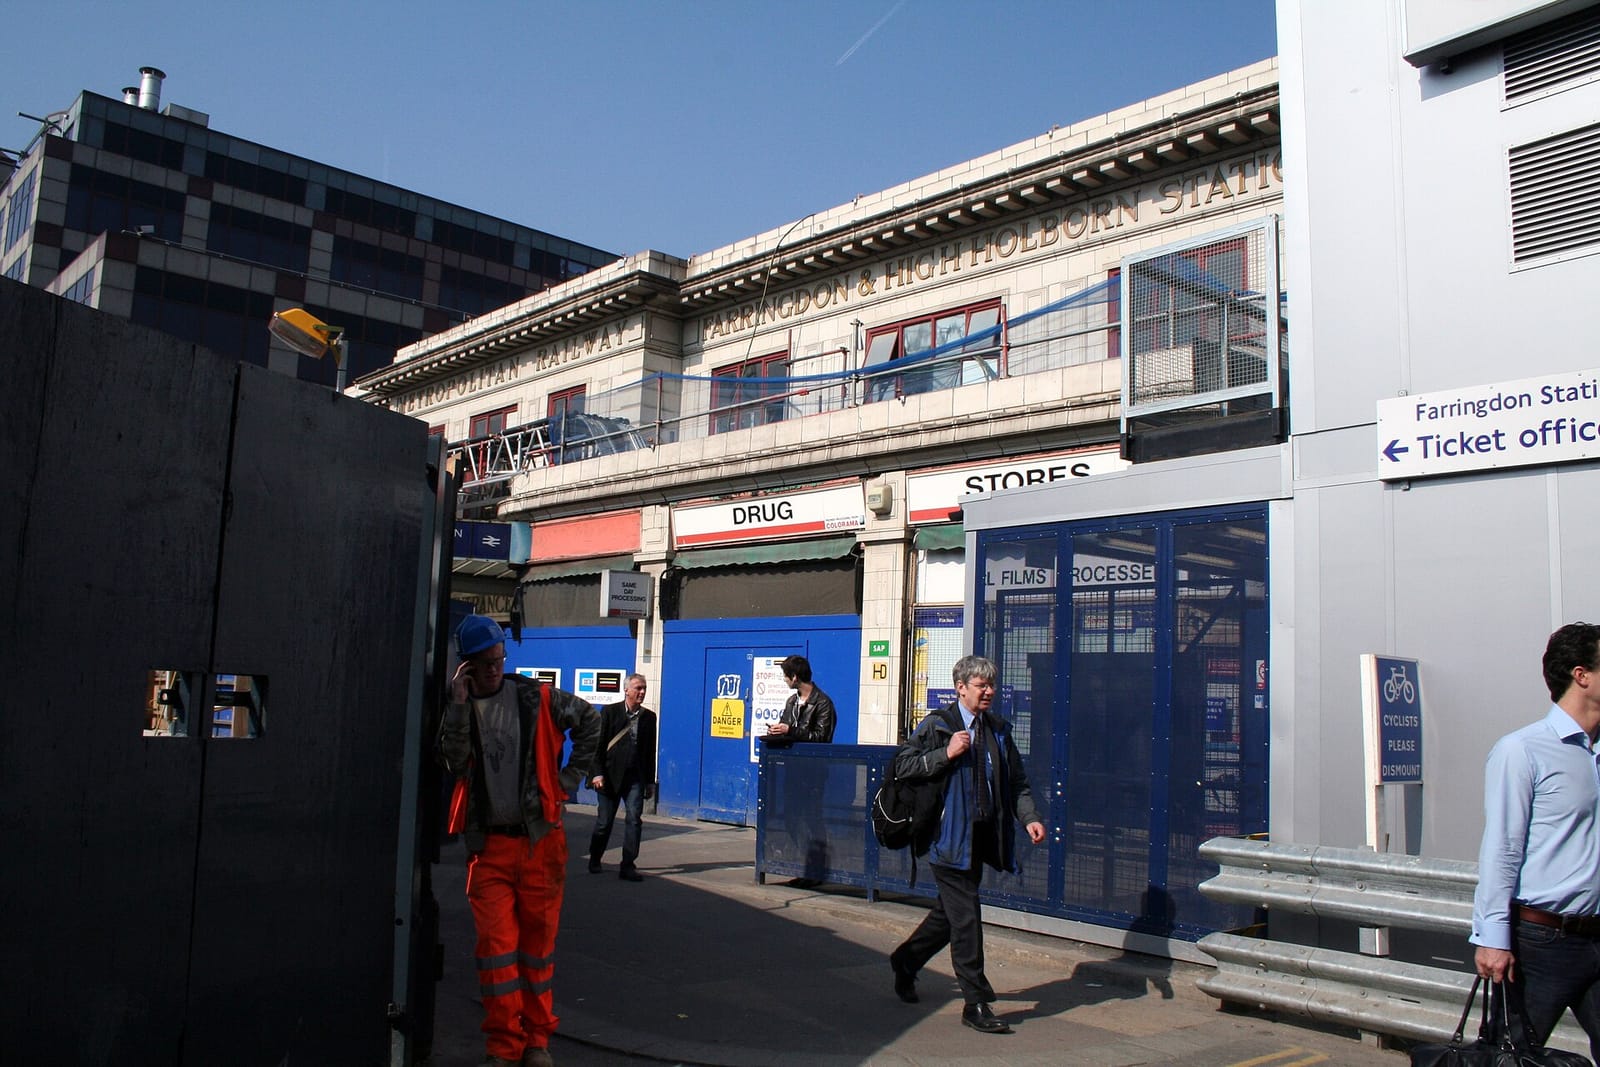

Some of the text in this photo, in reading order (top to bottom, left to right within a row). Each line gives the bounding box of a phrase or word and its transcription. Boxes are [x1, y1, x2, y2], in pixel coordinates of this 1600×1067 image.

[701, 275, 850, 341] FARRINGDON
[857, 268, 876, 297] &
[884, 240, 961, 291] HIGH
[969, 189, 1141, 267] HOLBORN
[396, 320, 629, 414] METROPOLITAN RAILWAY
[1416, 392, 1531, 422] Farringdon
[1416, 417, 1600, 459] Ticket offic
[732, 501, 793, 525] DRUG
[826, 519, 859, 529] COLORAMA
[1001, 568, 1047, 586] FILMS
[712, 716, 742, 726] DANGER
[1383, 714, 1418, 727] CYCLISTS
[1388, 740, 1415, 751] PLEASE
[1382, 765, 1420, 777] DISMOUNT
